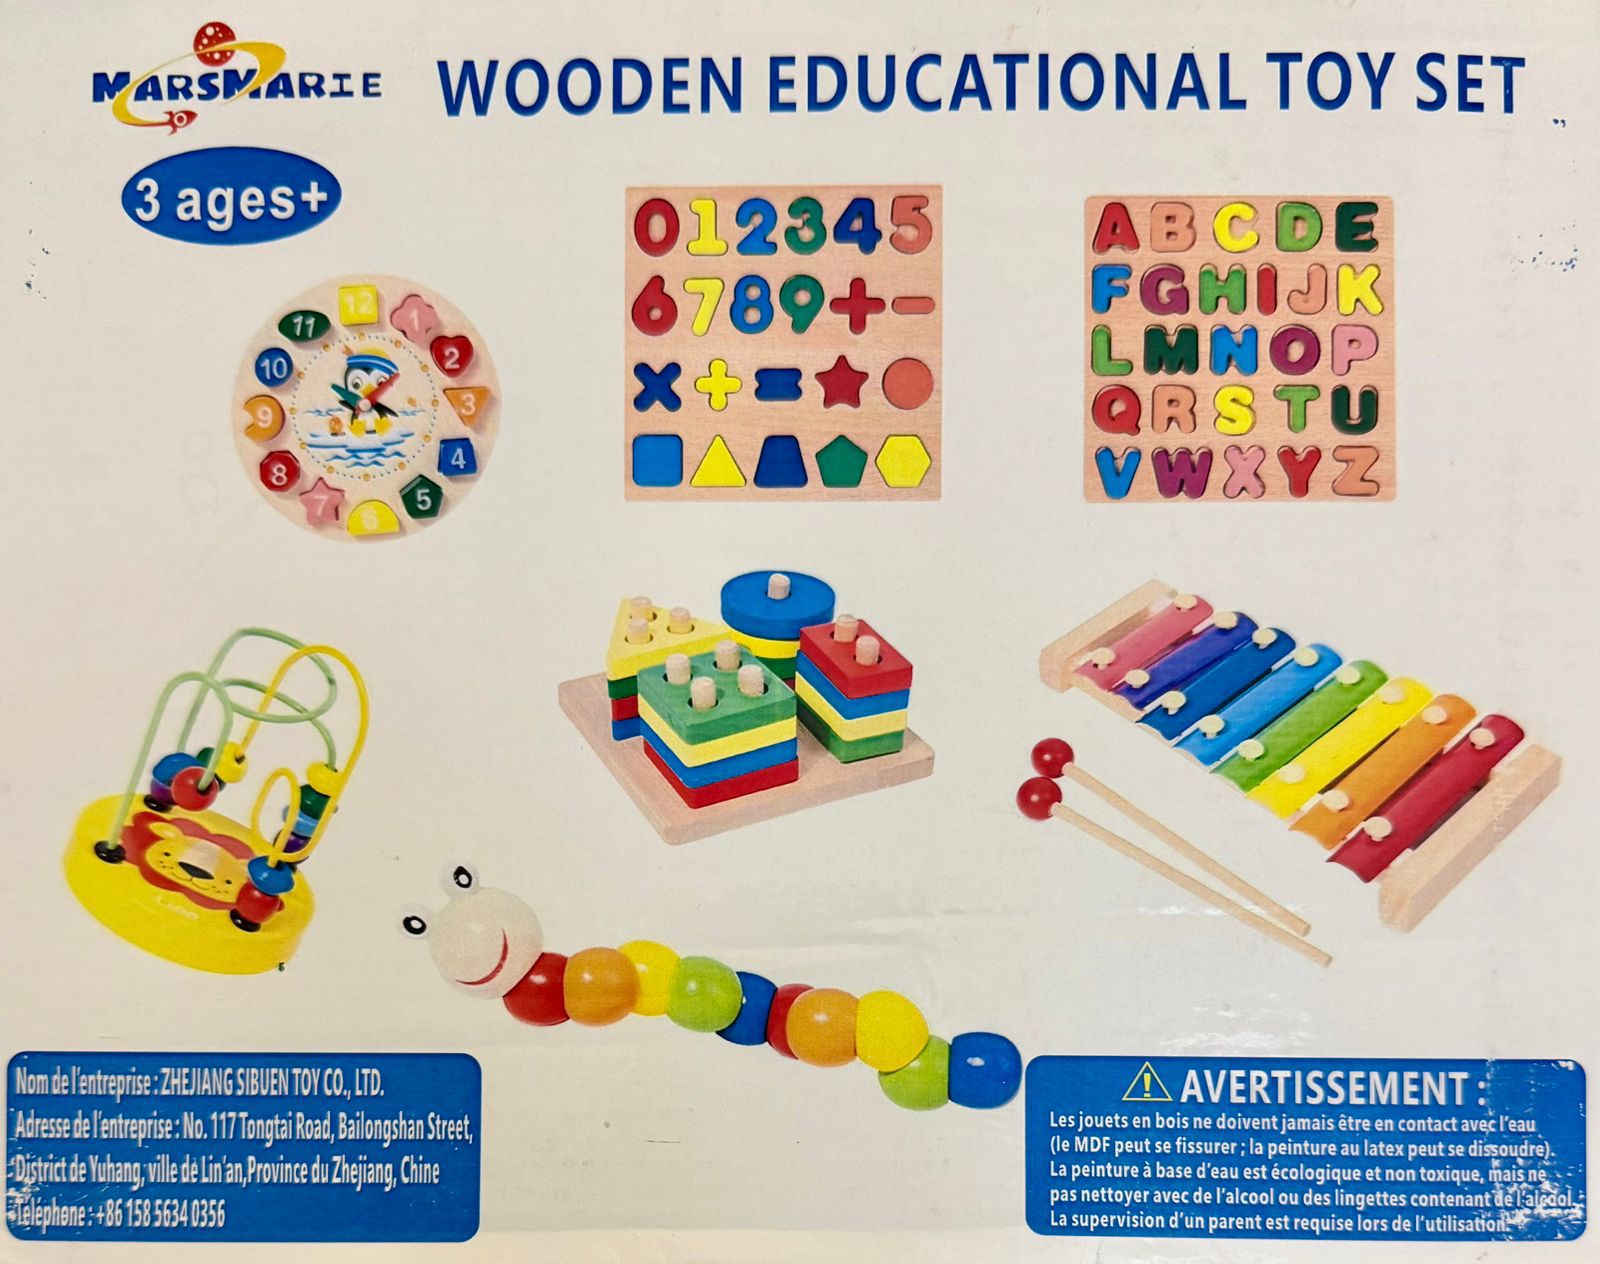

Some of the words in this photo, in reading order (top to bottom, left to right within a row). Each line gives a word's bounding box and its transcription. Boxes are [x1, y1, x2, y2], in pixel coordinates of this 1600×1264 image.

[92, 67, 383, 103] MARSMARIE
[436, 56, 743, 118] WOODEN
[768, 52, 1247, 115] EDUCATIONAL
[1265, 52, 1395, 112] TOY
[1415, 53, 1526, 115] SET
[135, 178, 161, 223] 3
[177, 180, 329, 231] ages+
[346, 293, 373, 315] 12
[293, 315, 316, 338] 11
[410, 310, 420, 329] 1
[261, 357, 288, 380] 10
[444, 348, 461, 370] 2
[257, 406, 272, 427] 9
[461, 395, 476, 416] 3
[451, 447, 467, 469] 4
[271, 464, 288, 485] 8
[314, 495, 329, 516] 7
[417, 488, 433, 511] 5
[362, 508, 380, 531] 6
[15, 1066, 49, 1094] Nom
[52, 1065, 69, 1095] de
[160, 1067, 233, 1096] ZHEJIANG
[236, 1067, 289, 1096] SIBUEN
[292, 1068, 320, 1096] TOY
[324, 1068, 351, 1100] CO.,
[355, 1068, 385, 1096] LTD.
[1180, 1069, 1469, 1106] AVERTISSEMENT
[15, 1109, 70, 1139] Adresse
[73, 1109, 90, 1139] de
[183, 1111, 208, 1139] No.
[211, 1111, 237, 1139] 117
[240, 1111, 293, 1148] Tongtai
[296, 1111, 335, 1144] Road,
[338, 1111, 424, 1148] Bailongshan
[427, 1112, 473, 1144] Street,
[1050, 1111, 1075, 1128] Les
[1078, 1111, 1129, 1132] jouets
[1133, 1117, 1151, 1129] en
[1156, 1112, 1189, 1129] bois
[1193, 1117, 1212, 1130] ne
[1216, 1113, 1278, 1130] doivent
[1280, 1113, 1334, 1134] jamais
[1338, 1114, 1371, 1131] être
[1375, 1119, 1394, 1132] en
[1398, 1116, 1457, 1132] contact
[1461, 1119, 1495, 1132] avec
[1050, 1135, 1070, 1155] (le
[1074, 1137, 1111, 1152] MDF
[1115, 1138, 1151, 1157] peut
[1155, 1140, 1171, 1153] se
[1175, 1137, 1237, 1154] fissurer
[1249, 1138, 1267, 1155] la
[1268, 1139, 1336, 1159] peinture
[1341, 1144, 1359, 1156] au
[1364, 1140, 1403, 1156] latex
[1408, 1141, 1444, 1161] peut
[1449, 1144, 1464, 1157] se
[15, 1153, 67, 1182] District
[70, 1153, 87, 1182] de
[89, 1154, 145, 1191] Yuhang,
[149, 1154, 178, 1183] ville
[181, 1154, 198, 1183] de
[311, 1154, 329, 1184] du
[332, 1154, 397, 1192] Zhejiang,
[401, 1155, 440, 1184] Chine
[1050, 1161, 1067, 1177] La
[1071, 1161, 1138, 1181] peinture
[1142, 1160, 1152, 1178] à
[1156, 1162, 1192, 1179] base
[1243, 1165, 1267, 1180] est
[1271, 1162, 1361, 1185] écologique
[1365, 1166, 1381, 1182] et
[1385, 1169, 1415, 1182] non
[1419, 1165, 1484, 1186] toxique,
[1488, 1164, 1525, 1182] mais
[1528, 1169, 1547, 1182] ne
[1050, 1191, 1077, 1206] pas
[1081, 1187, 1149, 1207] nettoyer
[1153, 1191, 1189, 1204] avec
[1193, 1187, 1212, 1204] de
[1278, 1192, 1299, 1205] ou
[1303, 1188, 1331, 1206] des
[1335, 1189, 1406, 1210] lingettes
[1410, 1191, 1490, 1207] contenant
[1494, 1190, 1513, 1207] de
[96, 1198, 123, 1226] +86
[126, 1199, 151, 1227] 158
[154, 1199, 189, 1227] 5634
[191, 1199, 226, 1227] 0356
[1050, 1210, 1067, 1227] La
[1071, 1211, 1165, 1231] supervision
[1208, 1214, 1262, 1233] parent
[1265, 1215, 1289, 1230] est
[1294, 1213, 1353, 1235] requise
[1357, 1214, 1387, 1231] lors
[1392, 1214, 1411, 1232] de
